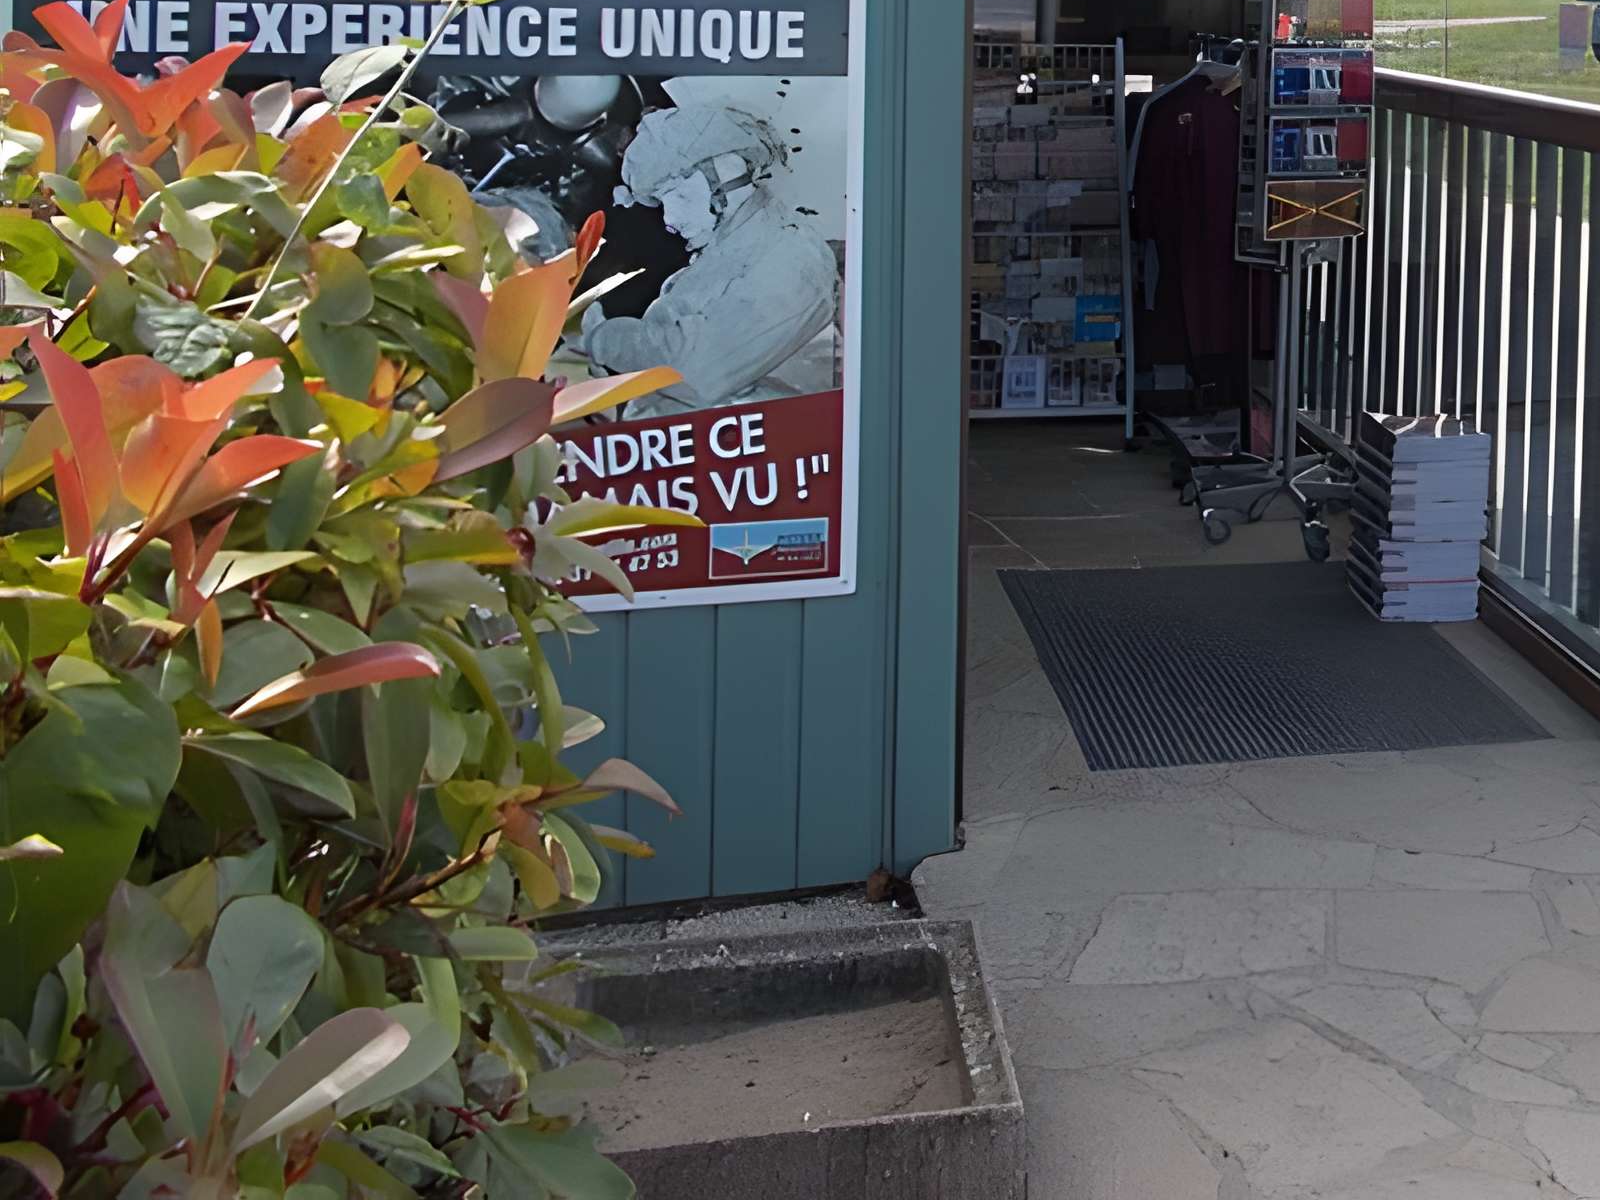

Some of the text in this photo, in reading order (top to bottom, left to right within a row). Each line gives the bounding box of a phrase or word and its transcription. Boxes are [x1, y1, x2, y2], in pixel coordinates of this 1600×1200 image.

[214, 1, 578, 57] EXPERIENCE
[601, 7, 805, 63] UNIQUE
[552, 412, 766, 484] NDRE CE
[709, 462, 778, 512] VU
